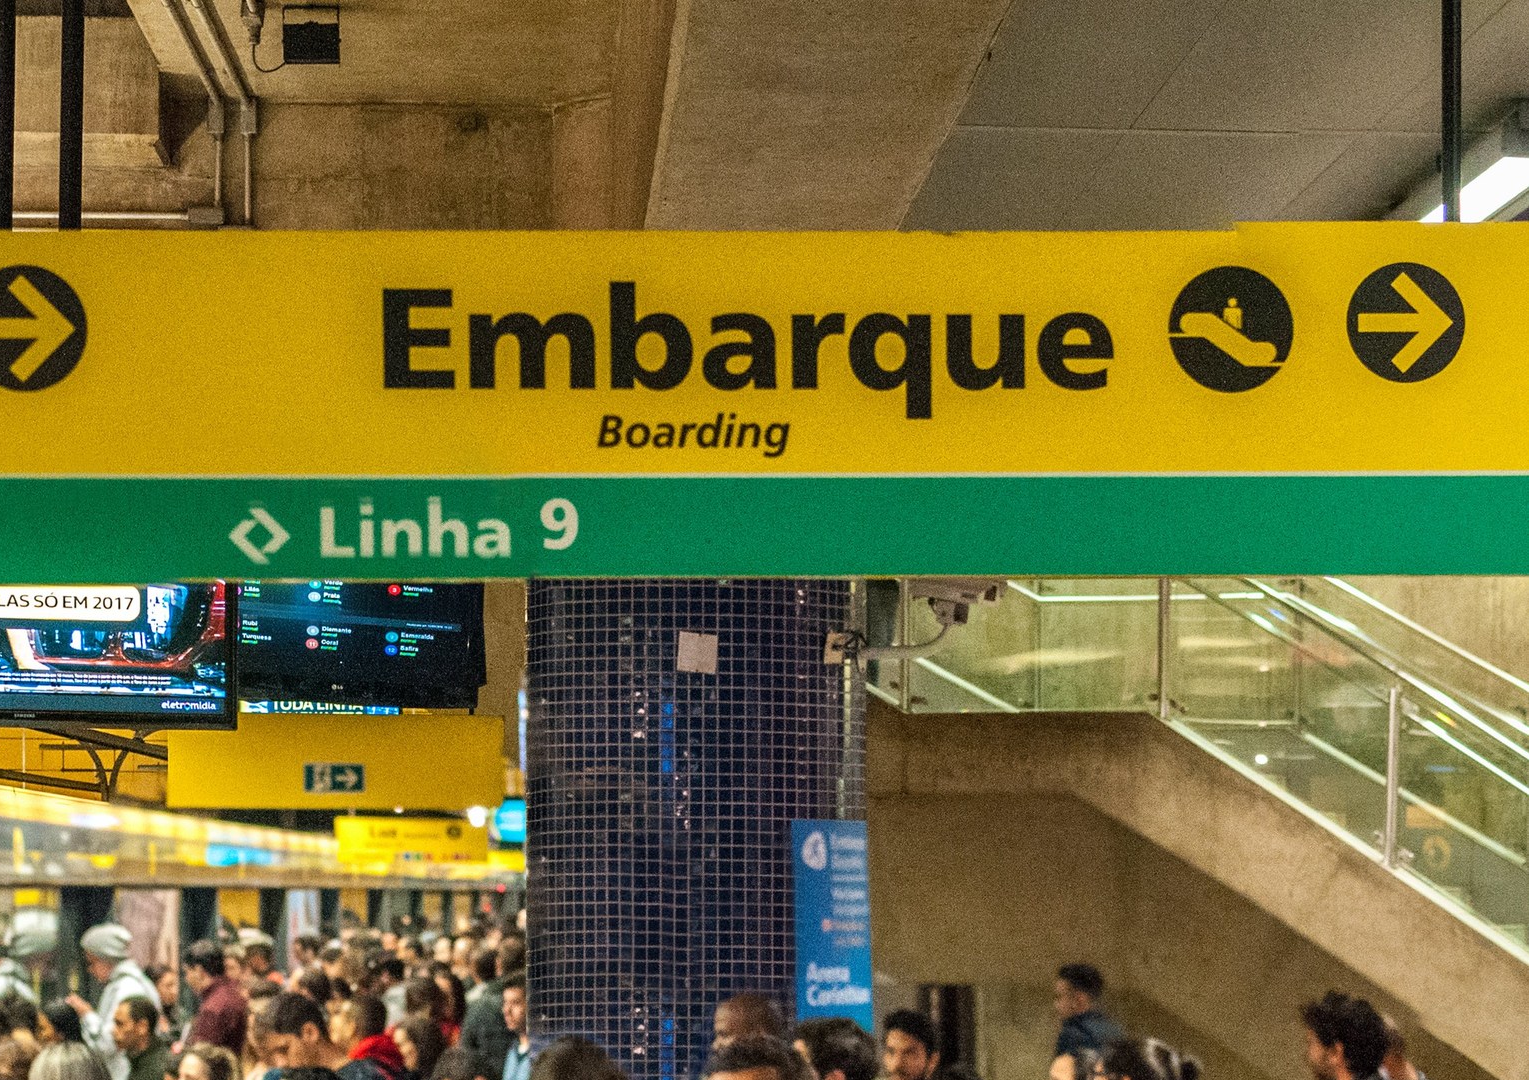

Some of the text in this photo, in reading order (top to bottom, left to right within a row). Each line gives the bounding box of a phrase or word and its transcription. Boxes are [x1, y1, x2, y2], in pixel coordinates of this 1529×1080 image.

[381, 281, 1115, 420] Embarque
[596, 412, 791, 459] Boarding
[318, 496, 579, 559] Linha 9
[402, 584, 434, 594] Vermelha
[33, 591, 59, 609] SÓ
[62, 595, 89, 610] EM
[92, 596, 134, 611] 2017
[321, 625, 352, 634] Diamante
[241, 633, 272, 642] Turquesa
[400, 632, 435, 641] Esmeralda
[321, 638, 339, 646] Coral
